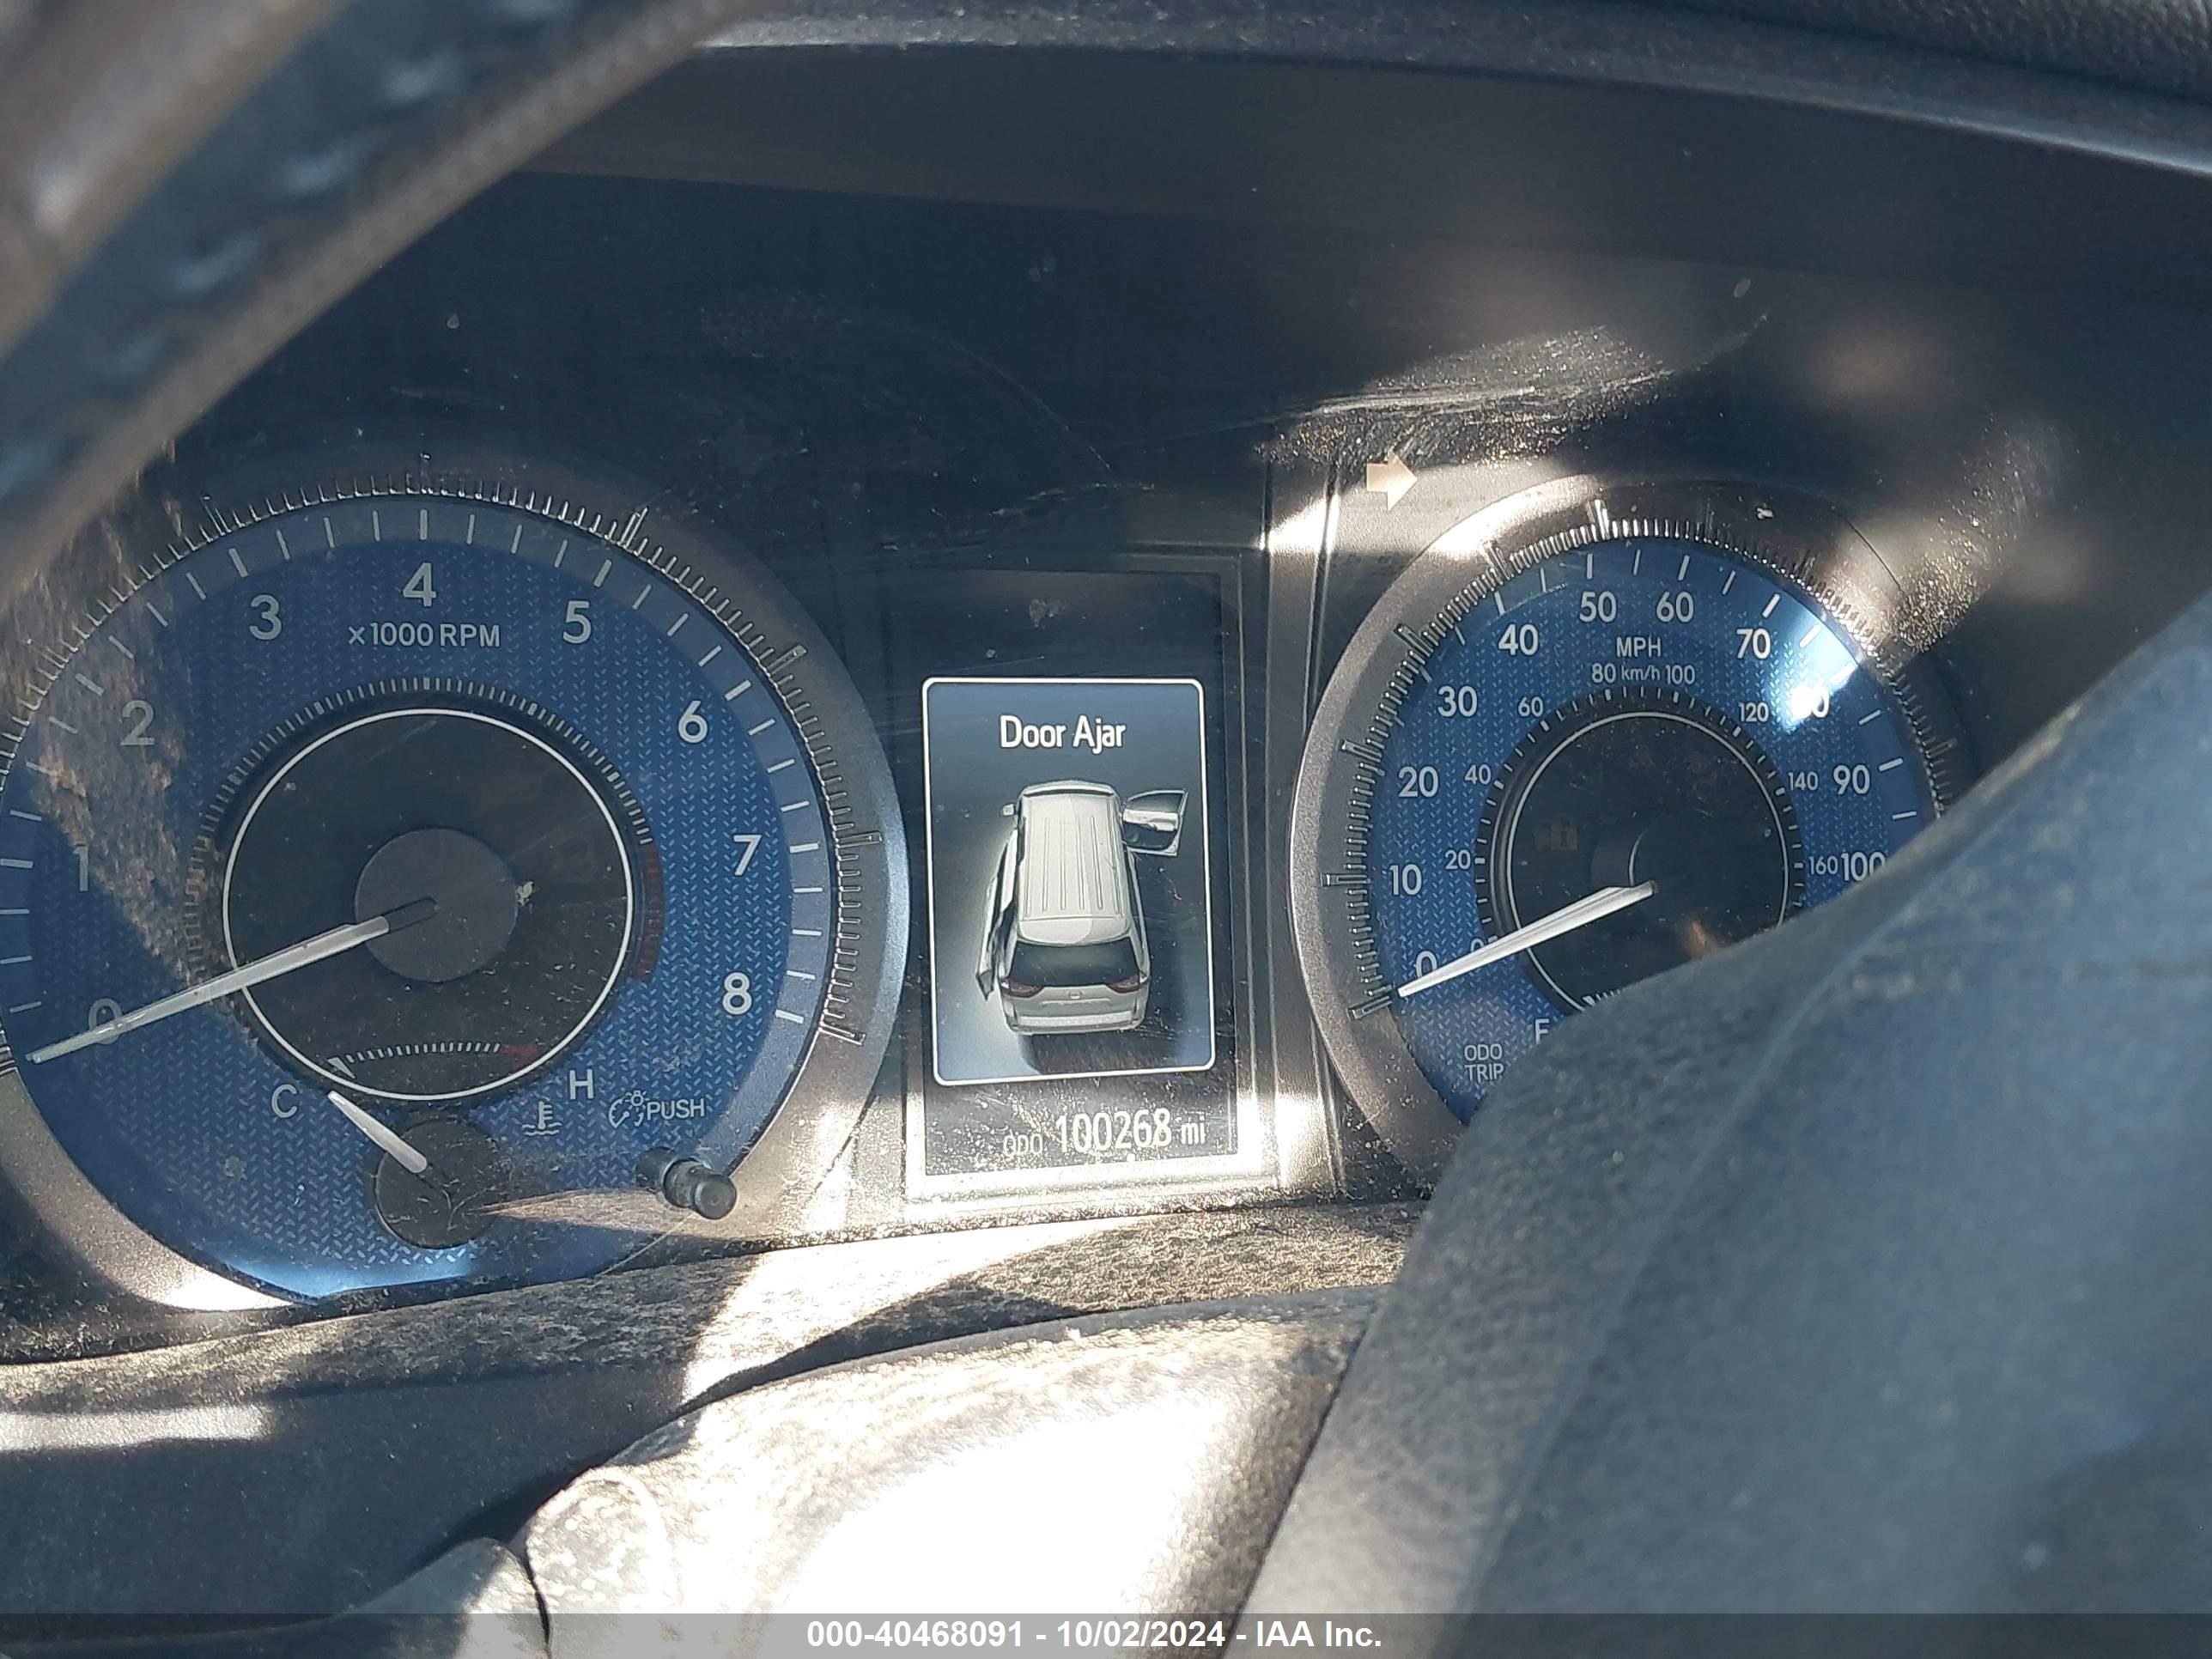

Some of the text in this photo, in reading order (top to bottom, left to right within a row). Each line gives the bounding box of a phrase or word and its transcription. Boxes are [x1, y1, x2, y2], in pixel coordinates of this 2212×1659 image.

[403, 562, 436, 606] 4
[250, 594, 283, 641] 3
[562, 600, 592, 644] 5
[1579, 591, 1617, 623] 50
[1656, 591, 1694, 623] 60
[440, 623, 500, 647] RPM
[1498, 623, 1540, 656] 40
[1616, 636, 1661, 658] MPH
[1736, 628, 1771, 659] 70
[1592, 663, 1696, 684] 80 km/h 100
[1437, 686, 1478, 717] 30
[1518, 696, 1543, 717] 60
[1739, 702, 1769, 722] 120
[1790, 685, 1830, 719] 0
[120, 700, 155, 746] 2
[678, 701, 708, 744] 6
[1000, 714, 1127, 754] Door Ajar
[1399, 766, 1438, 798] 20
[1465, 764, 1492, 785] 40
[1789, 772, 1818, 791] 140
[1833, 764, 1870, 795] 90
[73, 846, 88, 891] 1
[733, 834, 761, 876] 7
[1445, 850, 1471, 870] 20
[1809, 855, 1838, 875] 160
[1389, 865, 1422, 896] 10
[1415, 951, 1438, 979] 0
[722, 972, 752, 1016] 8
[88, 998, 122, 1044] 0
[1535, 1018, 1550, 1045] F
[1464, 1043, 1503, 1061] ODO
[568, 1069, 594, 1100] H
[1465, 1063, 1504, 1081] TRIP
[271, 1084, 298, 1118] C
[647, 1098, 706, 1120] PUSH
[1003, 1108, 1206, 1156] ODO 100268 mi
